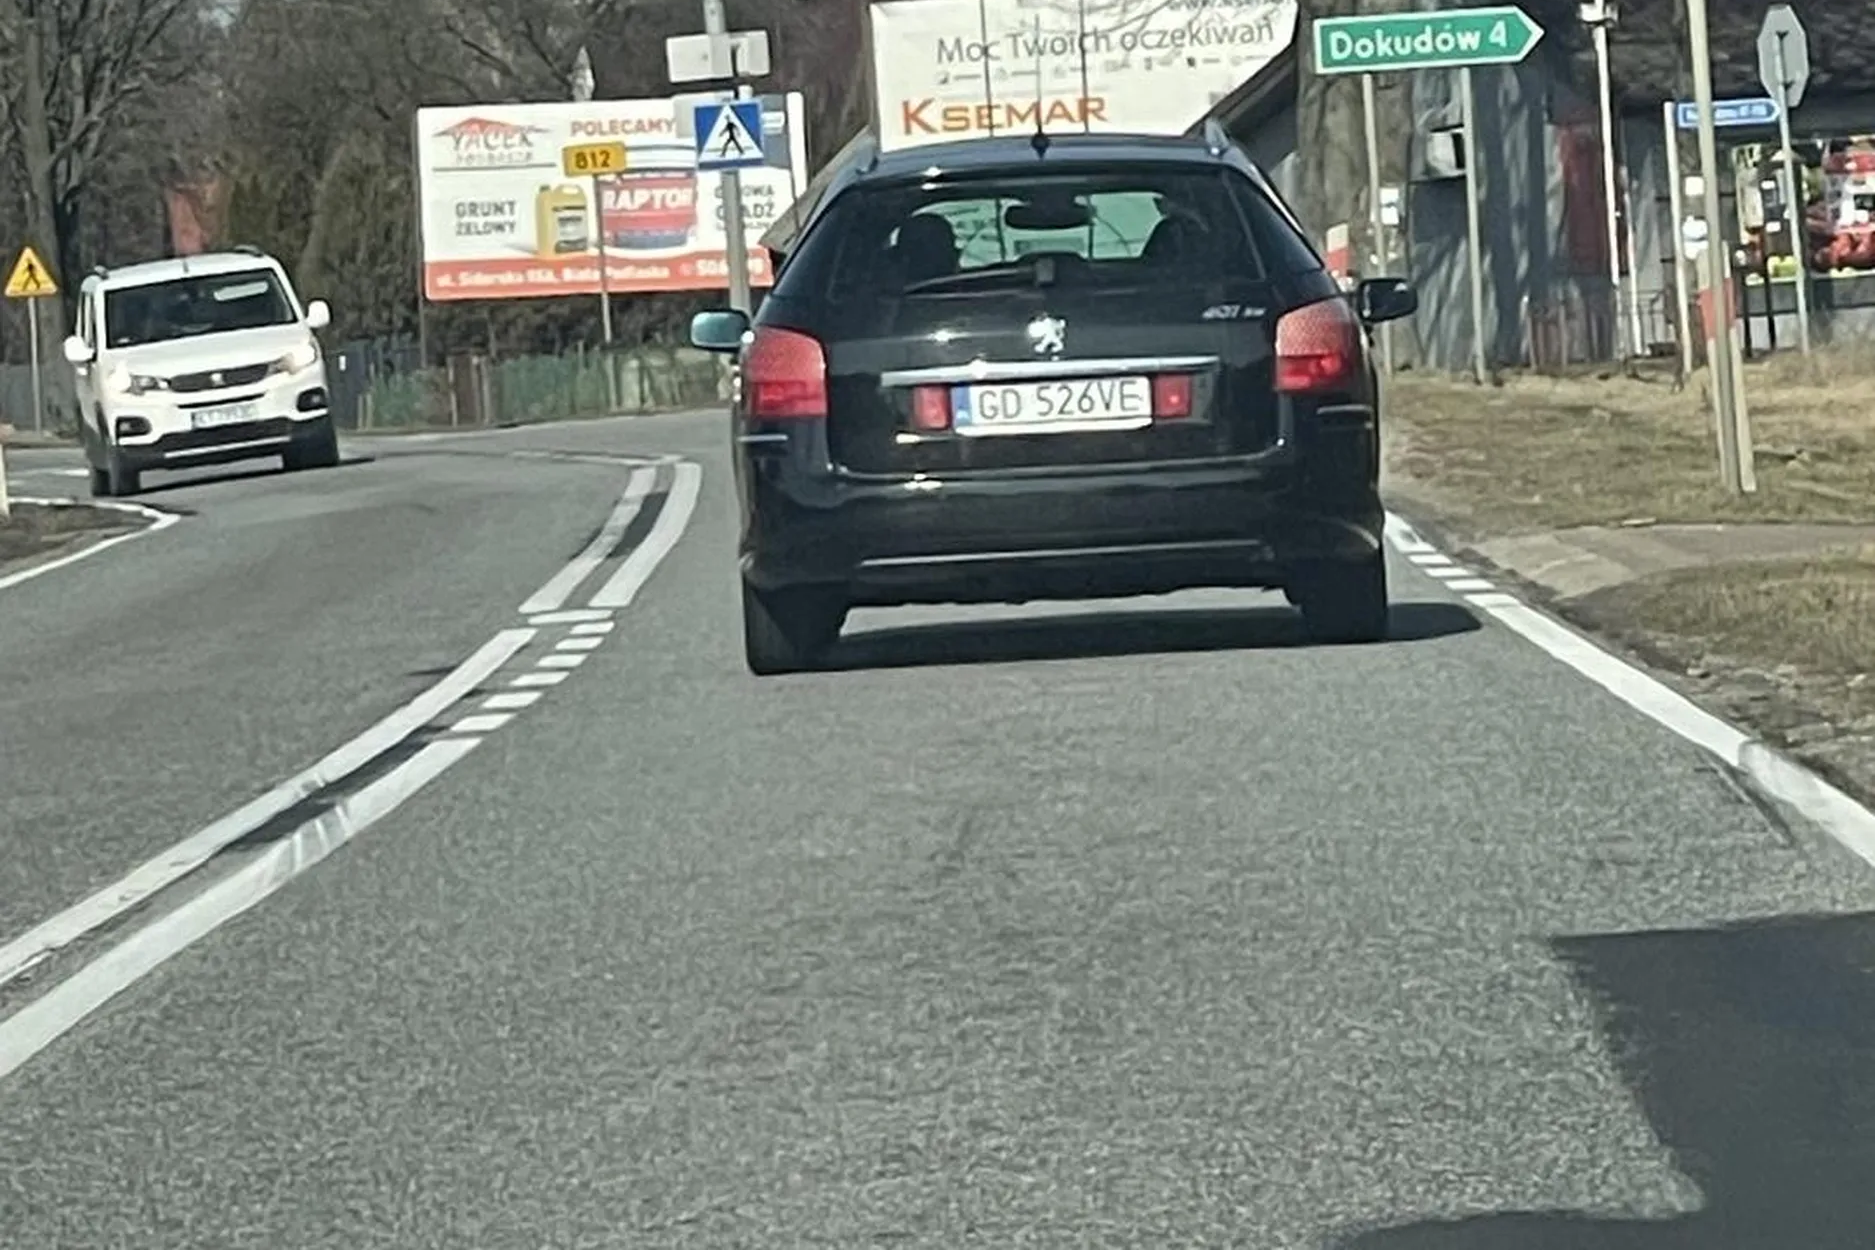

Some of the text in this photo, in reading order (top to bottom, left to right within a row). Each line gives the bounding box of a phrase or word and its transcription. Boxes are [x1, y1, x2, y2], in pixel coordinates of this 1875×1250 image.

[936, 15, 1276, 65] Moc Twoich oczekiwań
[1328, 19, 1508, 60] Dokudów 4
[570, 117, 676, 137] POLECAMY
[574, 149, 611, 170] 812
[455, 200, 517, 217] GRUNT
[978, 379, 1146, 420] GD 526VE
